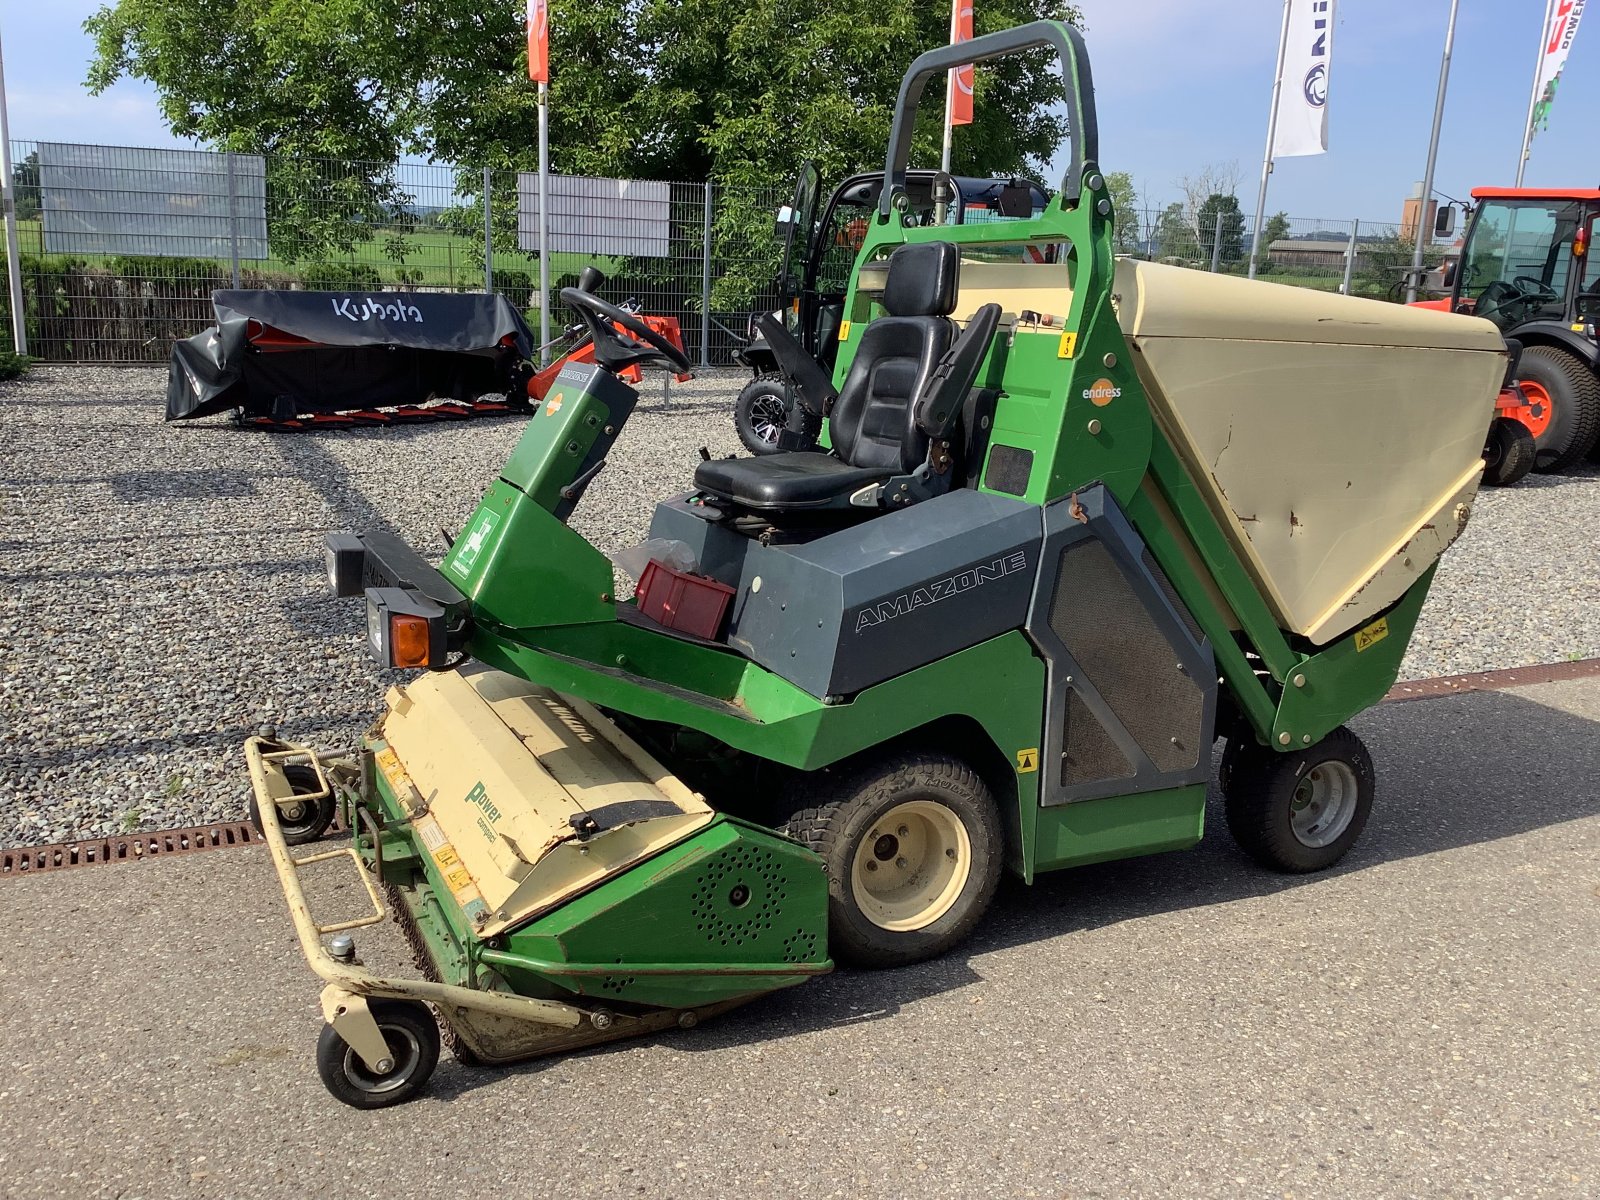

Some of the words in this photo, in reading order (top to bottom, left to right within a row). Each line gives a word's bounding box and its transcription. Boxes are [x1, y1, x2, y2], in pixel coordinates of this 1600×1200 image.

[331, 297, 424, 323] Kubota
[1082, 385, 1122, 399] endress
[855, 551, 1027, 633] AMAZONE
[464, 780, 503, 824] Power
[476, 816, 498, 845] compact
